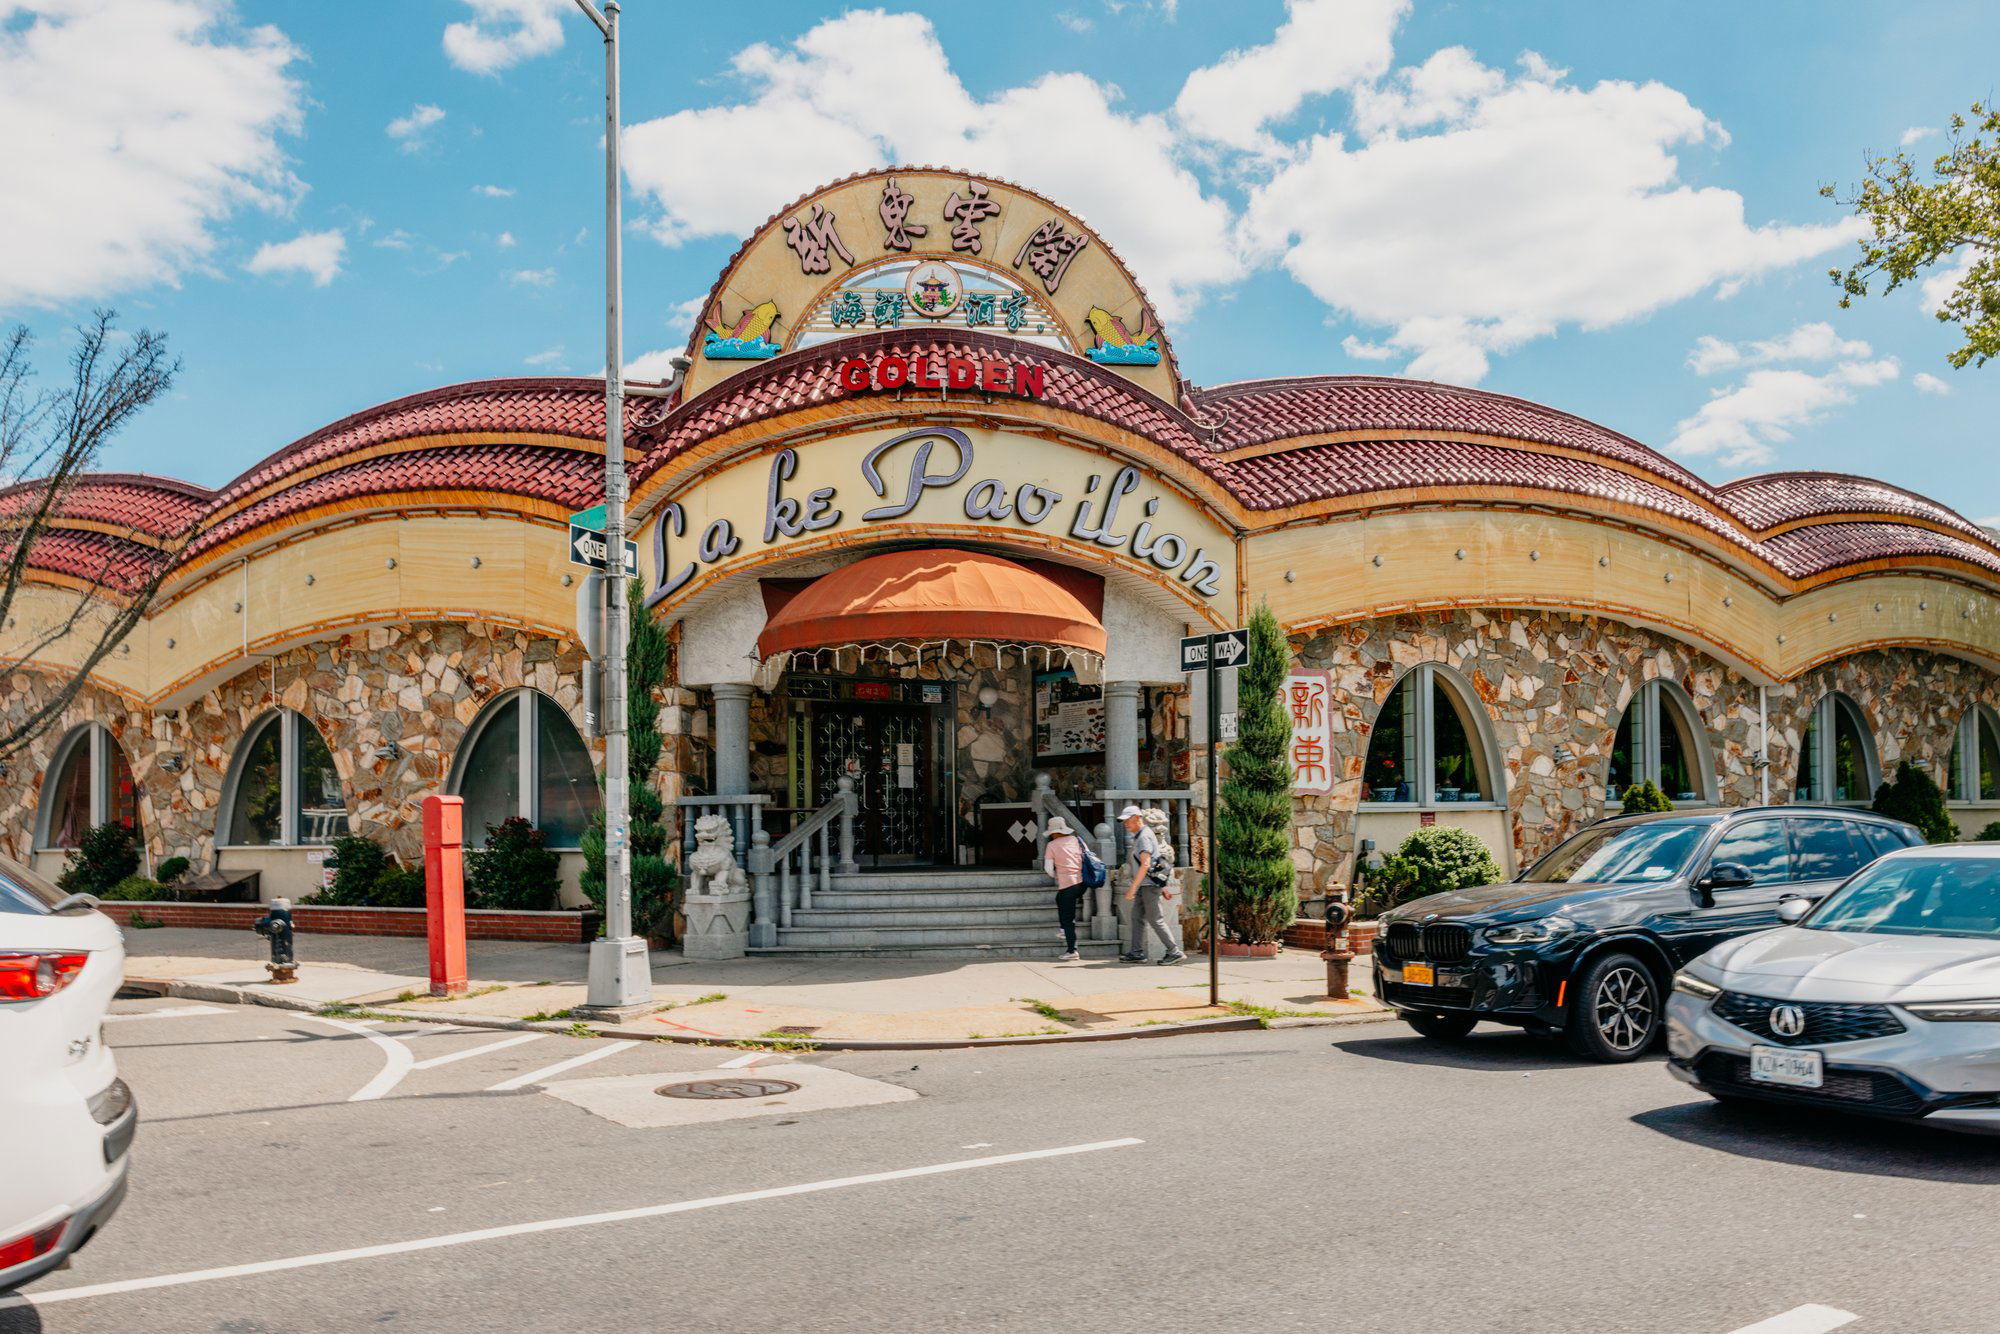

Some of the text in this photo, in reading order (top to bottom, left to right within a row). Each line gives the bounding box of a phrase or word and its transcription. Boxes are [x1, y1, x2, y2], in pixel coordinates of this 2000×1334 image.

[841, 357, 1044, 398] GOLDEN
[644, 427, 1222, 609] Lake Pavilion
[583, 540, 604, 558] ONE
[1190, 642, 1238, 661] ONE WAY
